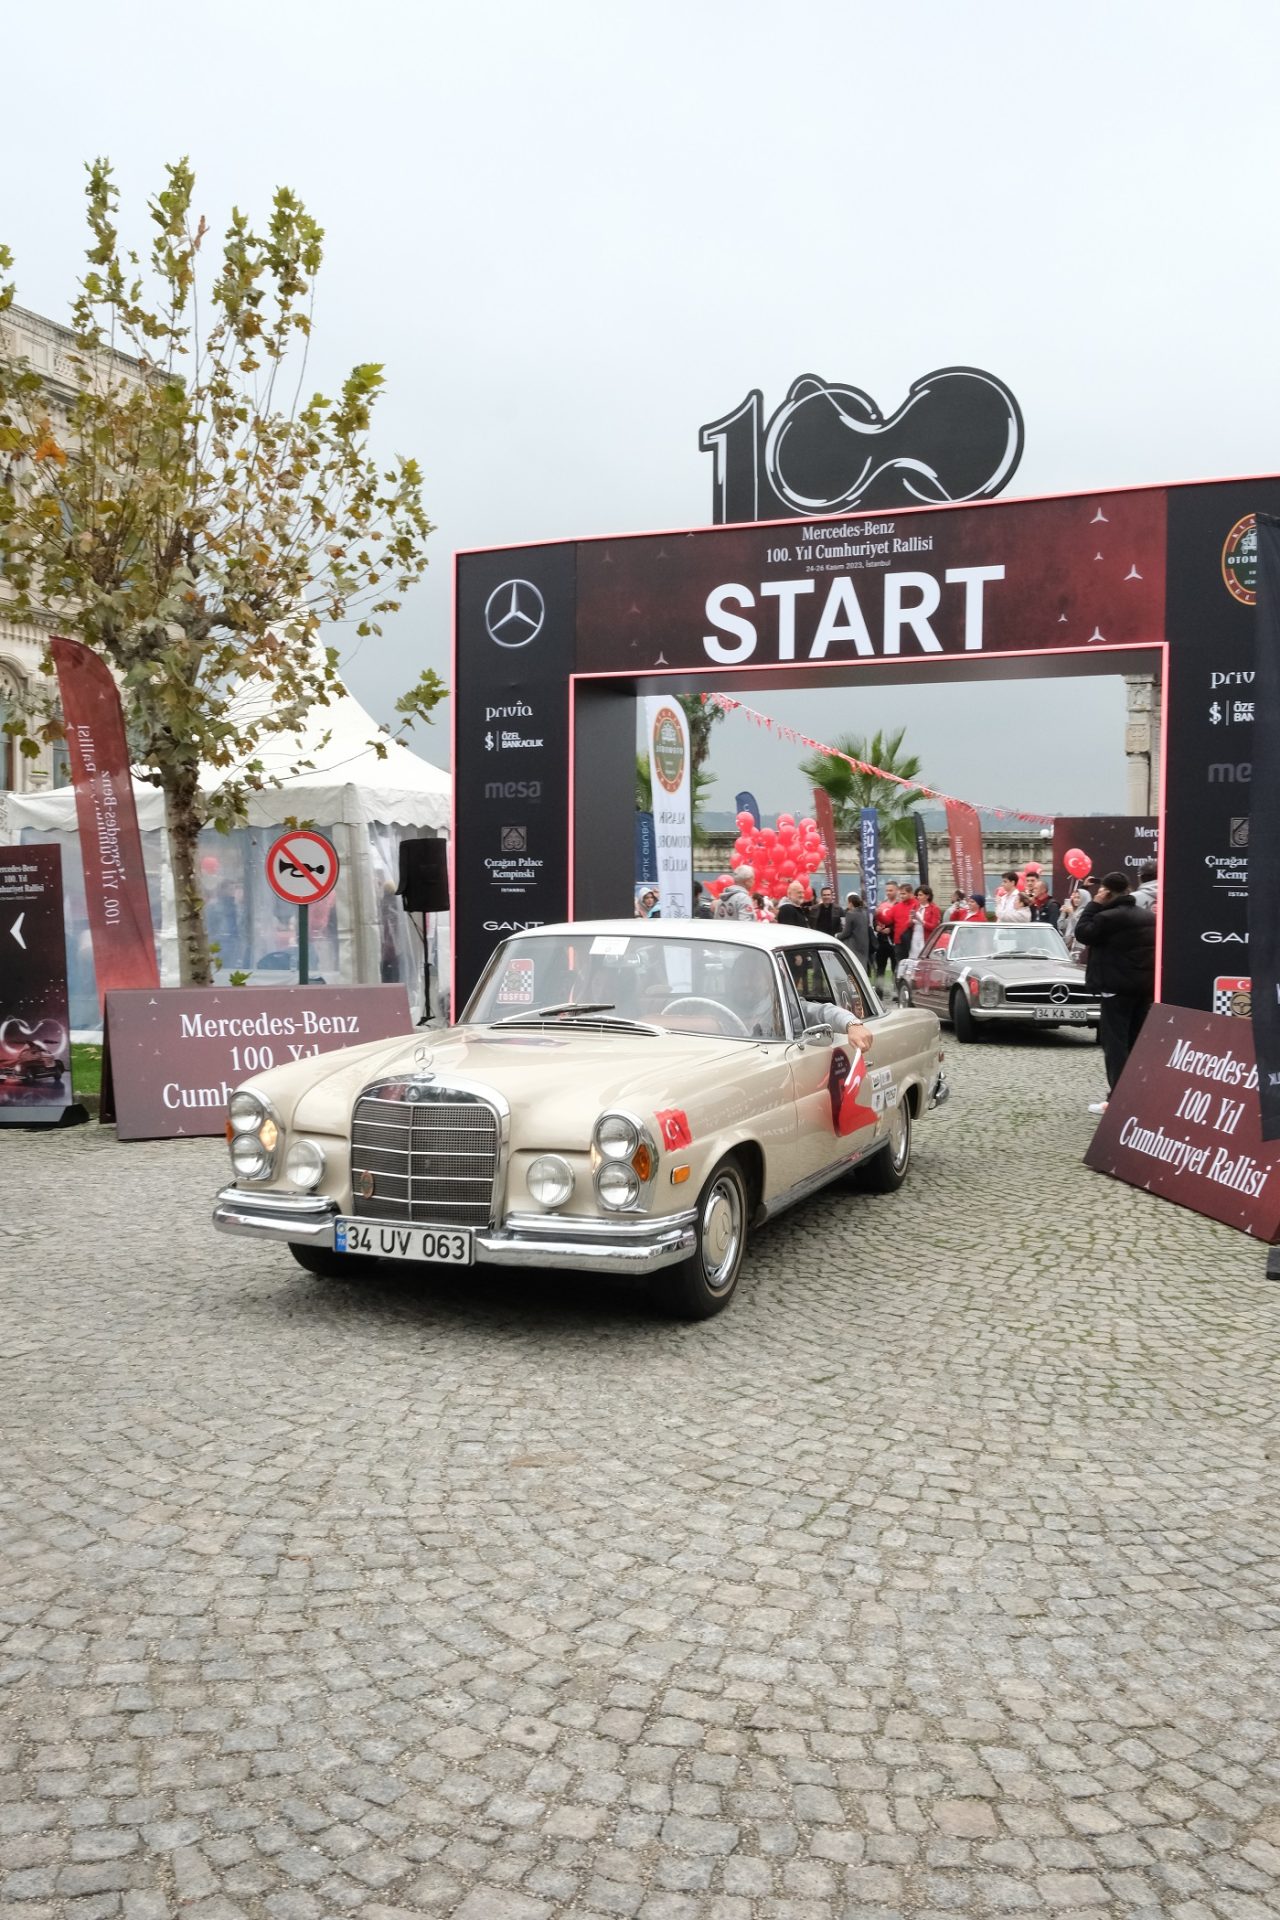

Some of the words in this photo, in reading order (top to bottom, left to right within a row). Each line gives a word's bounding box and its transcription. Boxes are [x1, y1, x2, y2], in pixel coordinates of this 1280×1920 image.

[802, 521, 895, 541] Mercedes-Benz
[766, 547, 792, 563] 100.
[795, 545, 812, 561] Yıl
[815, 540, 890, 559] Cumhuriyet
[893, 536, 933, 553] Rallisi
[1227, 555, 1257, 564] OTOM
[702, 564, 1006, 665] START
[1209, 671, 1256, 689] priv
[1233, 700, 1255, 712] ÖZE
[1233, 712, 1255, 722] BAN
[501, 730, 521, 740] ÖZEL
[501, 739, 544, 749] BANKACILIK
[1208, 762, 1253, 783] me
[484, 780, 541, 799] mesa
[1134, 826, 1158, 838] Merc
[518, 857, 544, 867] Palace
[492, 869, 536, 880] Kempinski
[1200, 931, 1250, 943] GA
[1037, 1009, 1049, 1018] 34
[1053, 1009, 1065, 1018] KA
[1069, 1009, 1086, 1019] 300
[179, 1010, 360, 1038] Mercedes-Benz
[1166, 1038, 1259, 1092] Mercedes-B
[162, 1081, 234, 1109] Cumh
[1174, 1087, 1211, 1126] 100.
[1213, 1098, 1246, 1135] Yıl
[1119, 1116, 1212, 1176] Cumhuriyet
[1205, 1146, 1272, 1199] Rallisi
[348, 1226, 372, 1252] 34
[380, 1229, 412, 1255] UV
[422, 1233, 465, 1260] 063
